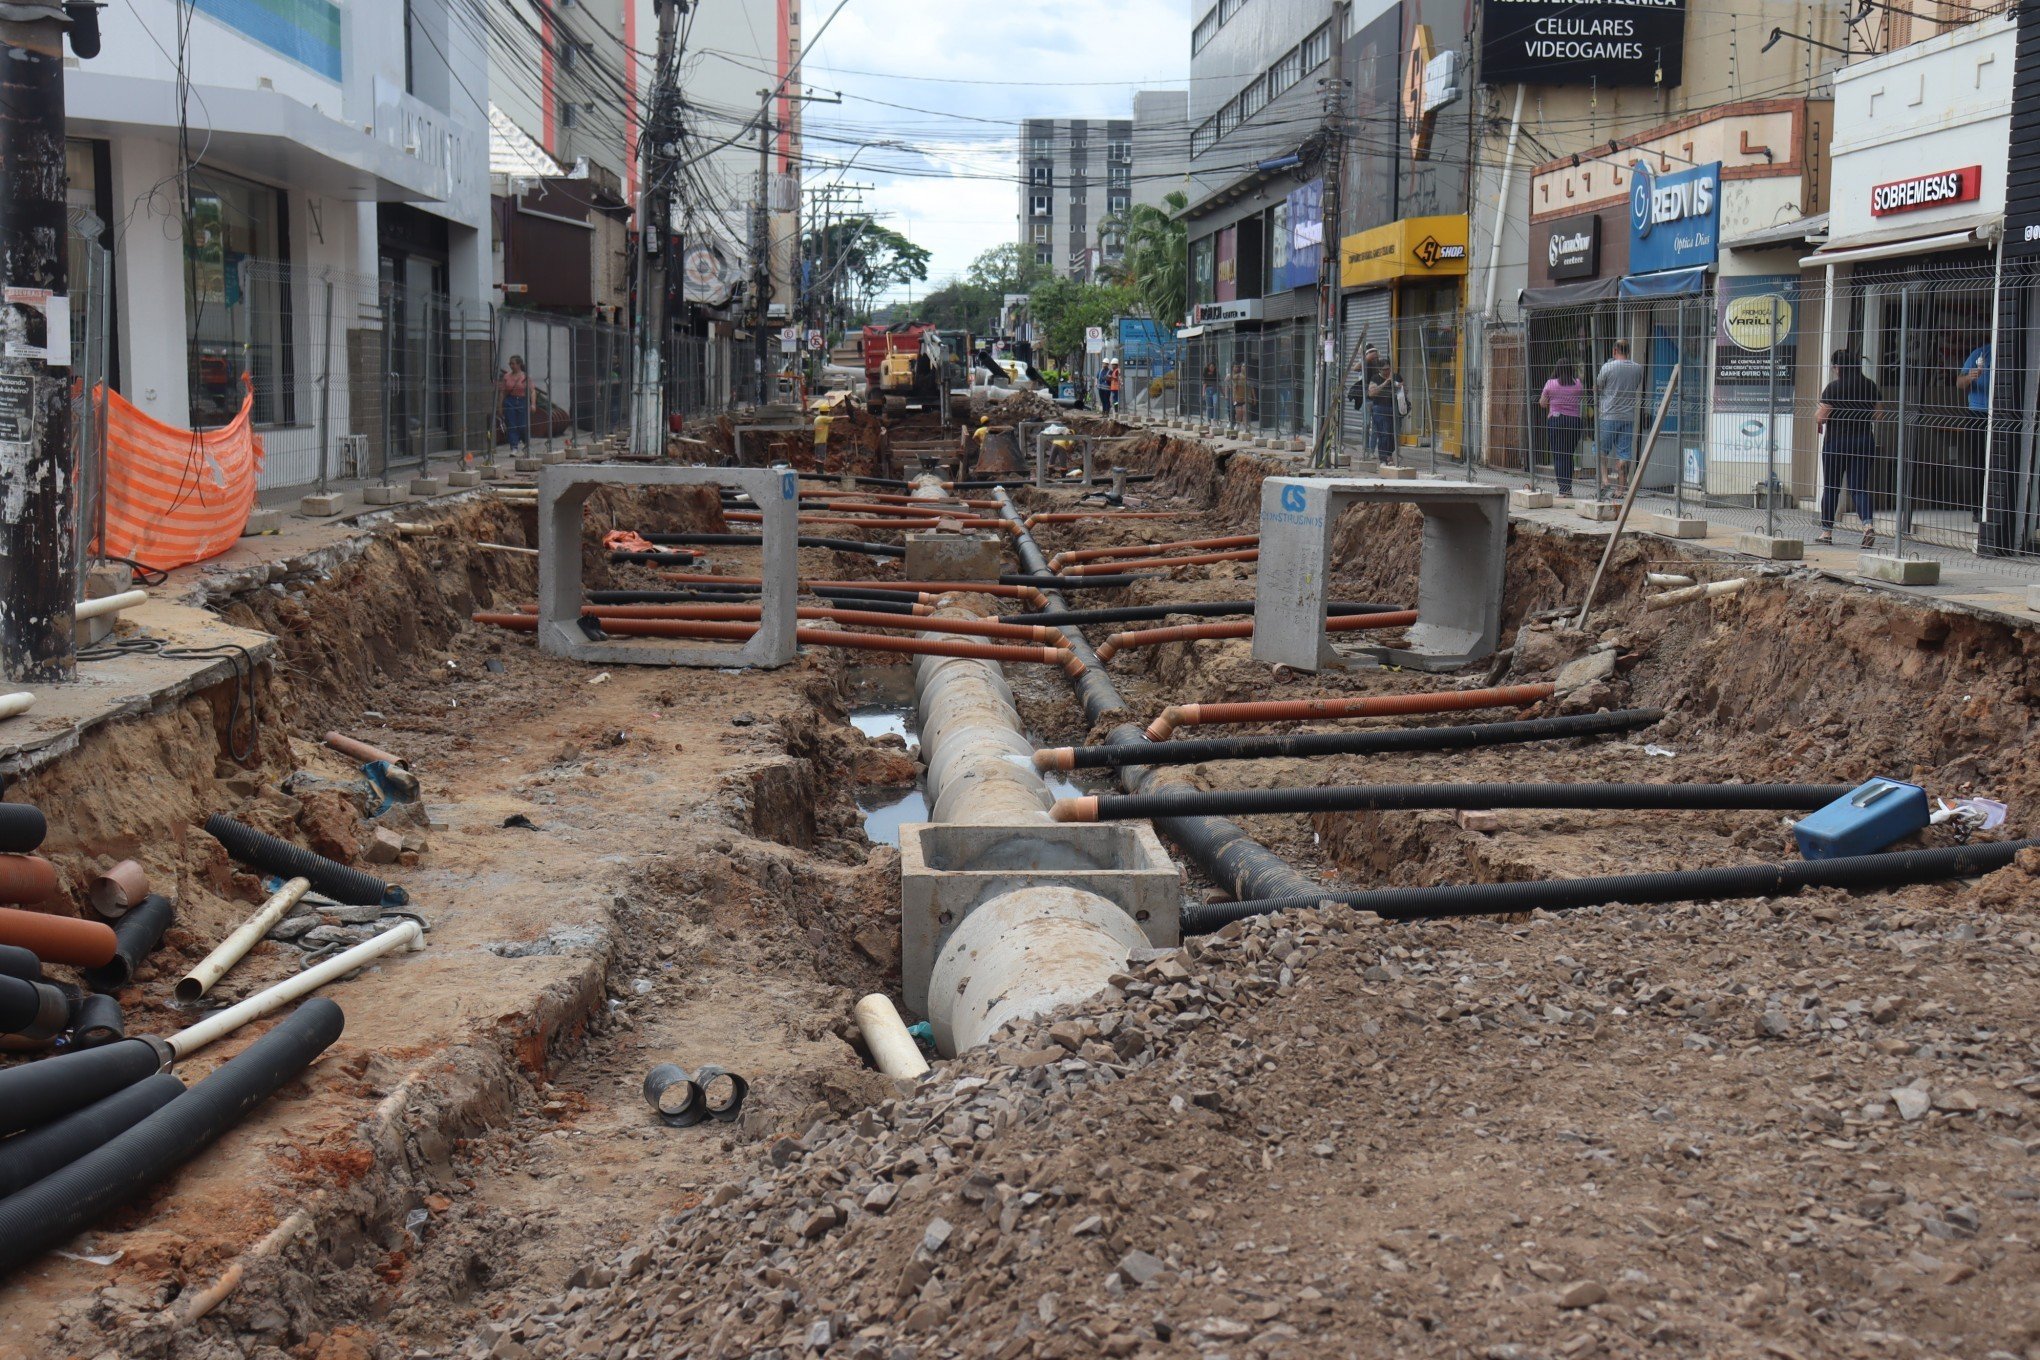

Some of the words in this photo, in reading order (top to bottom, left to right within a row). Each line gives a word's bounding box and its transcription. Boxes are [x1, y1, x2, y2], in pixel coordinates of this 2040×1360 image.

[1535, 18, 1634, 36] CELULARES
[1525, 41, 1643, 59] VIDEOGAMES
[1651, 177, 1714, 224] REDVIS
[1873, 173, 1957, 211] SOBREMESAS
[1674, 233, 1694, 254] Óptica
[1695, 231, 1711, 247] Dias
[1281, 484, 1306, 513] CS
